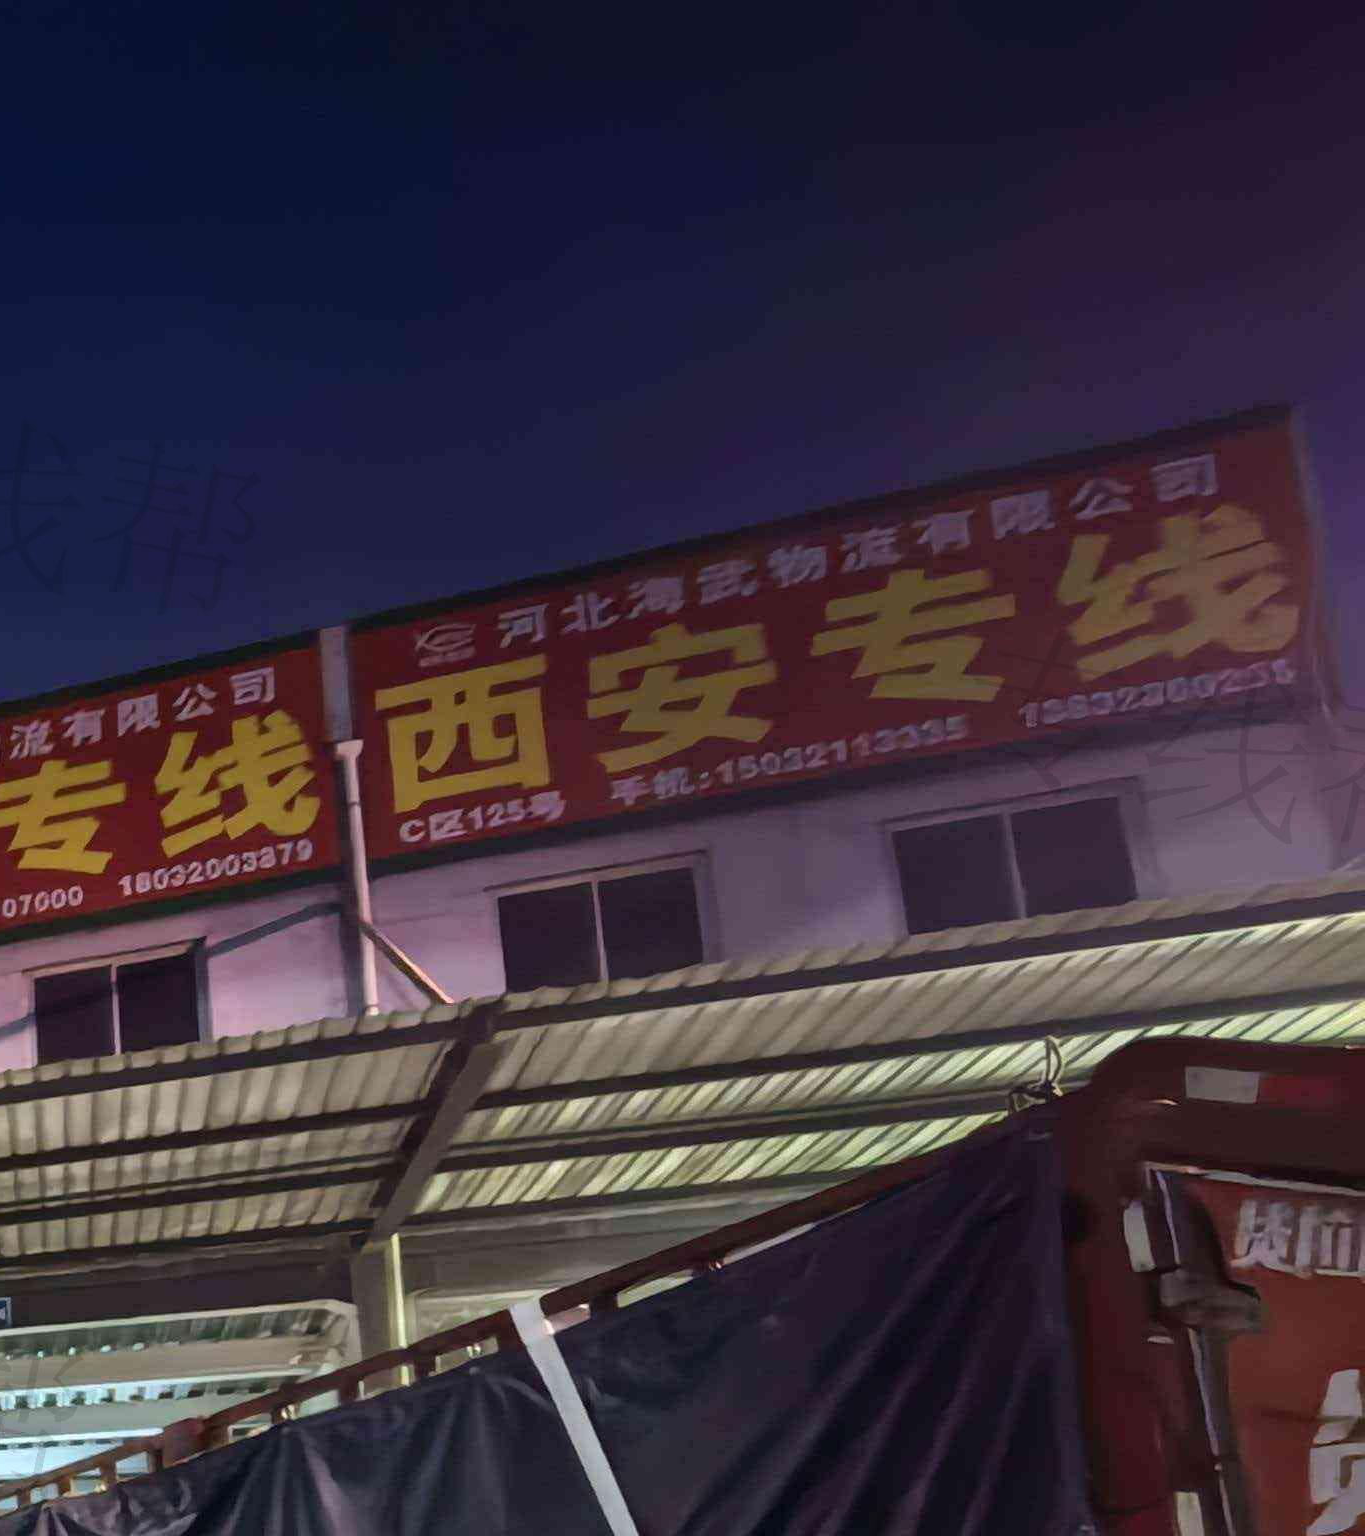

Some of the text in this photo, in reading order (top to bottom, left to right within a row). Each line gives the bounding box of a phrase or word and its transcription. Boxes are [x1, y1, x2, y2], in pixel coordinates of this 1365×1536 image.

[497, 454, 1220, 650] 河北海武物流有限公司
[375, 503, 1300, 811] 西安专线
[399, 790, 566, 844] C区125号
